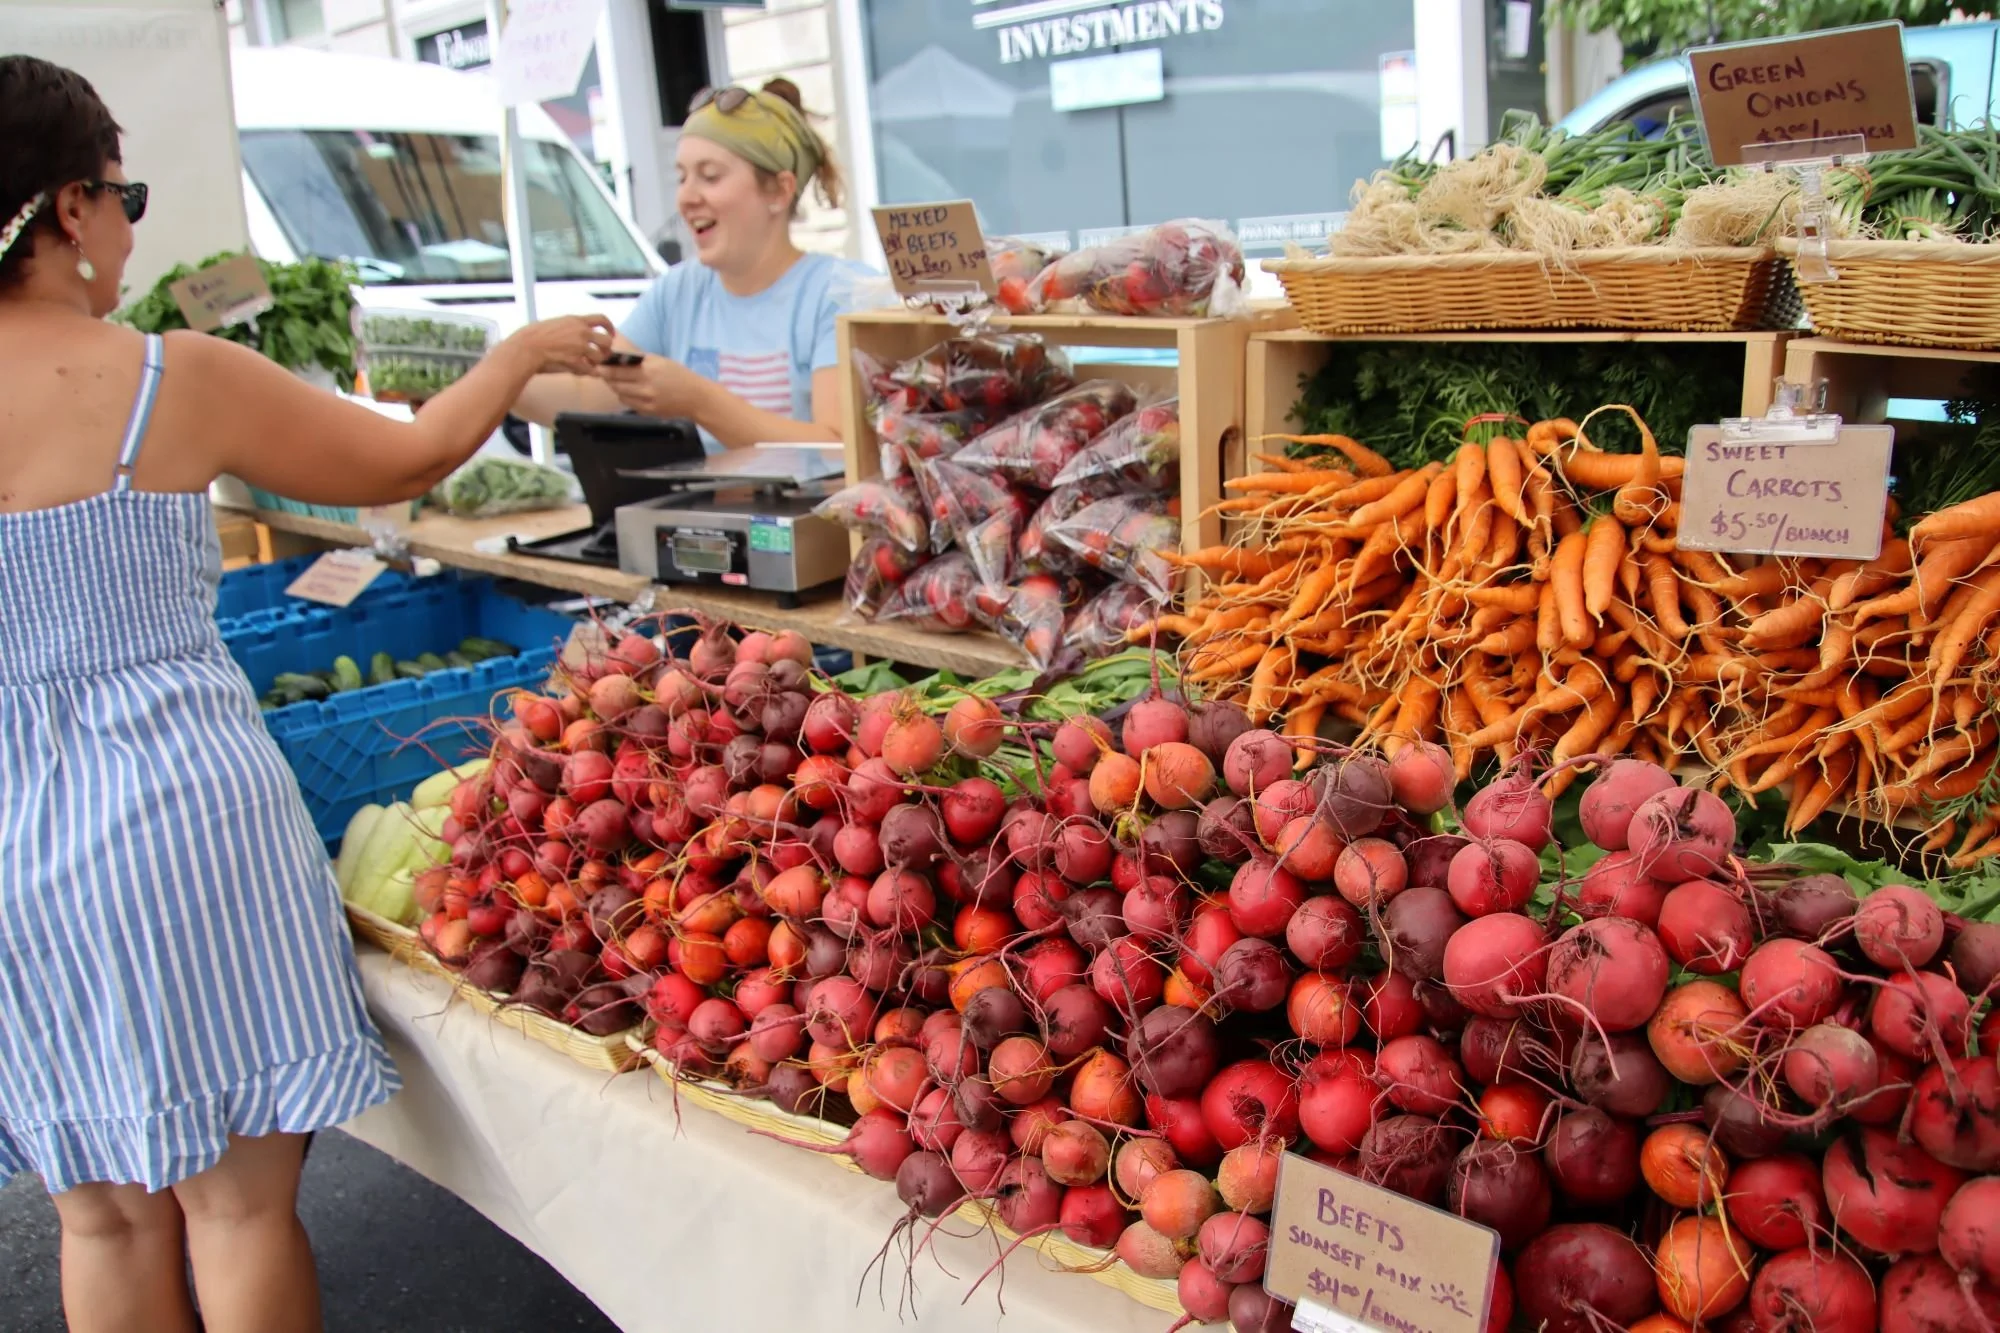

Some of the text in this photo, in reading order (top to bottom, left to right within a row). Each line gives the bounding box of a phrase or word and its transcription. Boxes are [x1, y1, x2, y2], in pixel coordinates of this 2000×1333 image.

[997, 0, 1224, 64] INVESTMENTS
[1709, 56, 1805, 92] GREEN
[1747, 80, 1867, 117] ONIONS
[888, 207, 948, 229] MIXED
[907, 231, 958, 255] BEETS
[1706, 442, 1795, 462] SWEET
[1726, 469, 1842, 501] CARROTS
[1317, 1188, 1404, 1252] BEETS
[1288, 1225, 1422, 1292] SUNSET MIX
